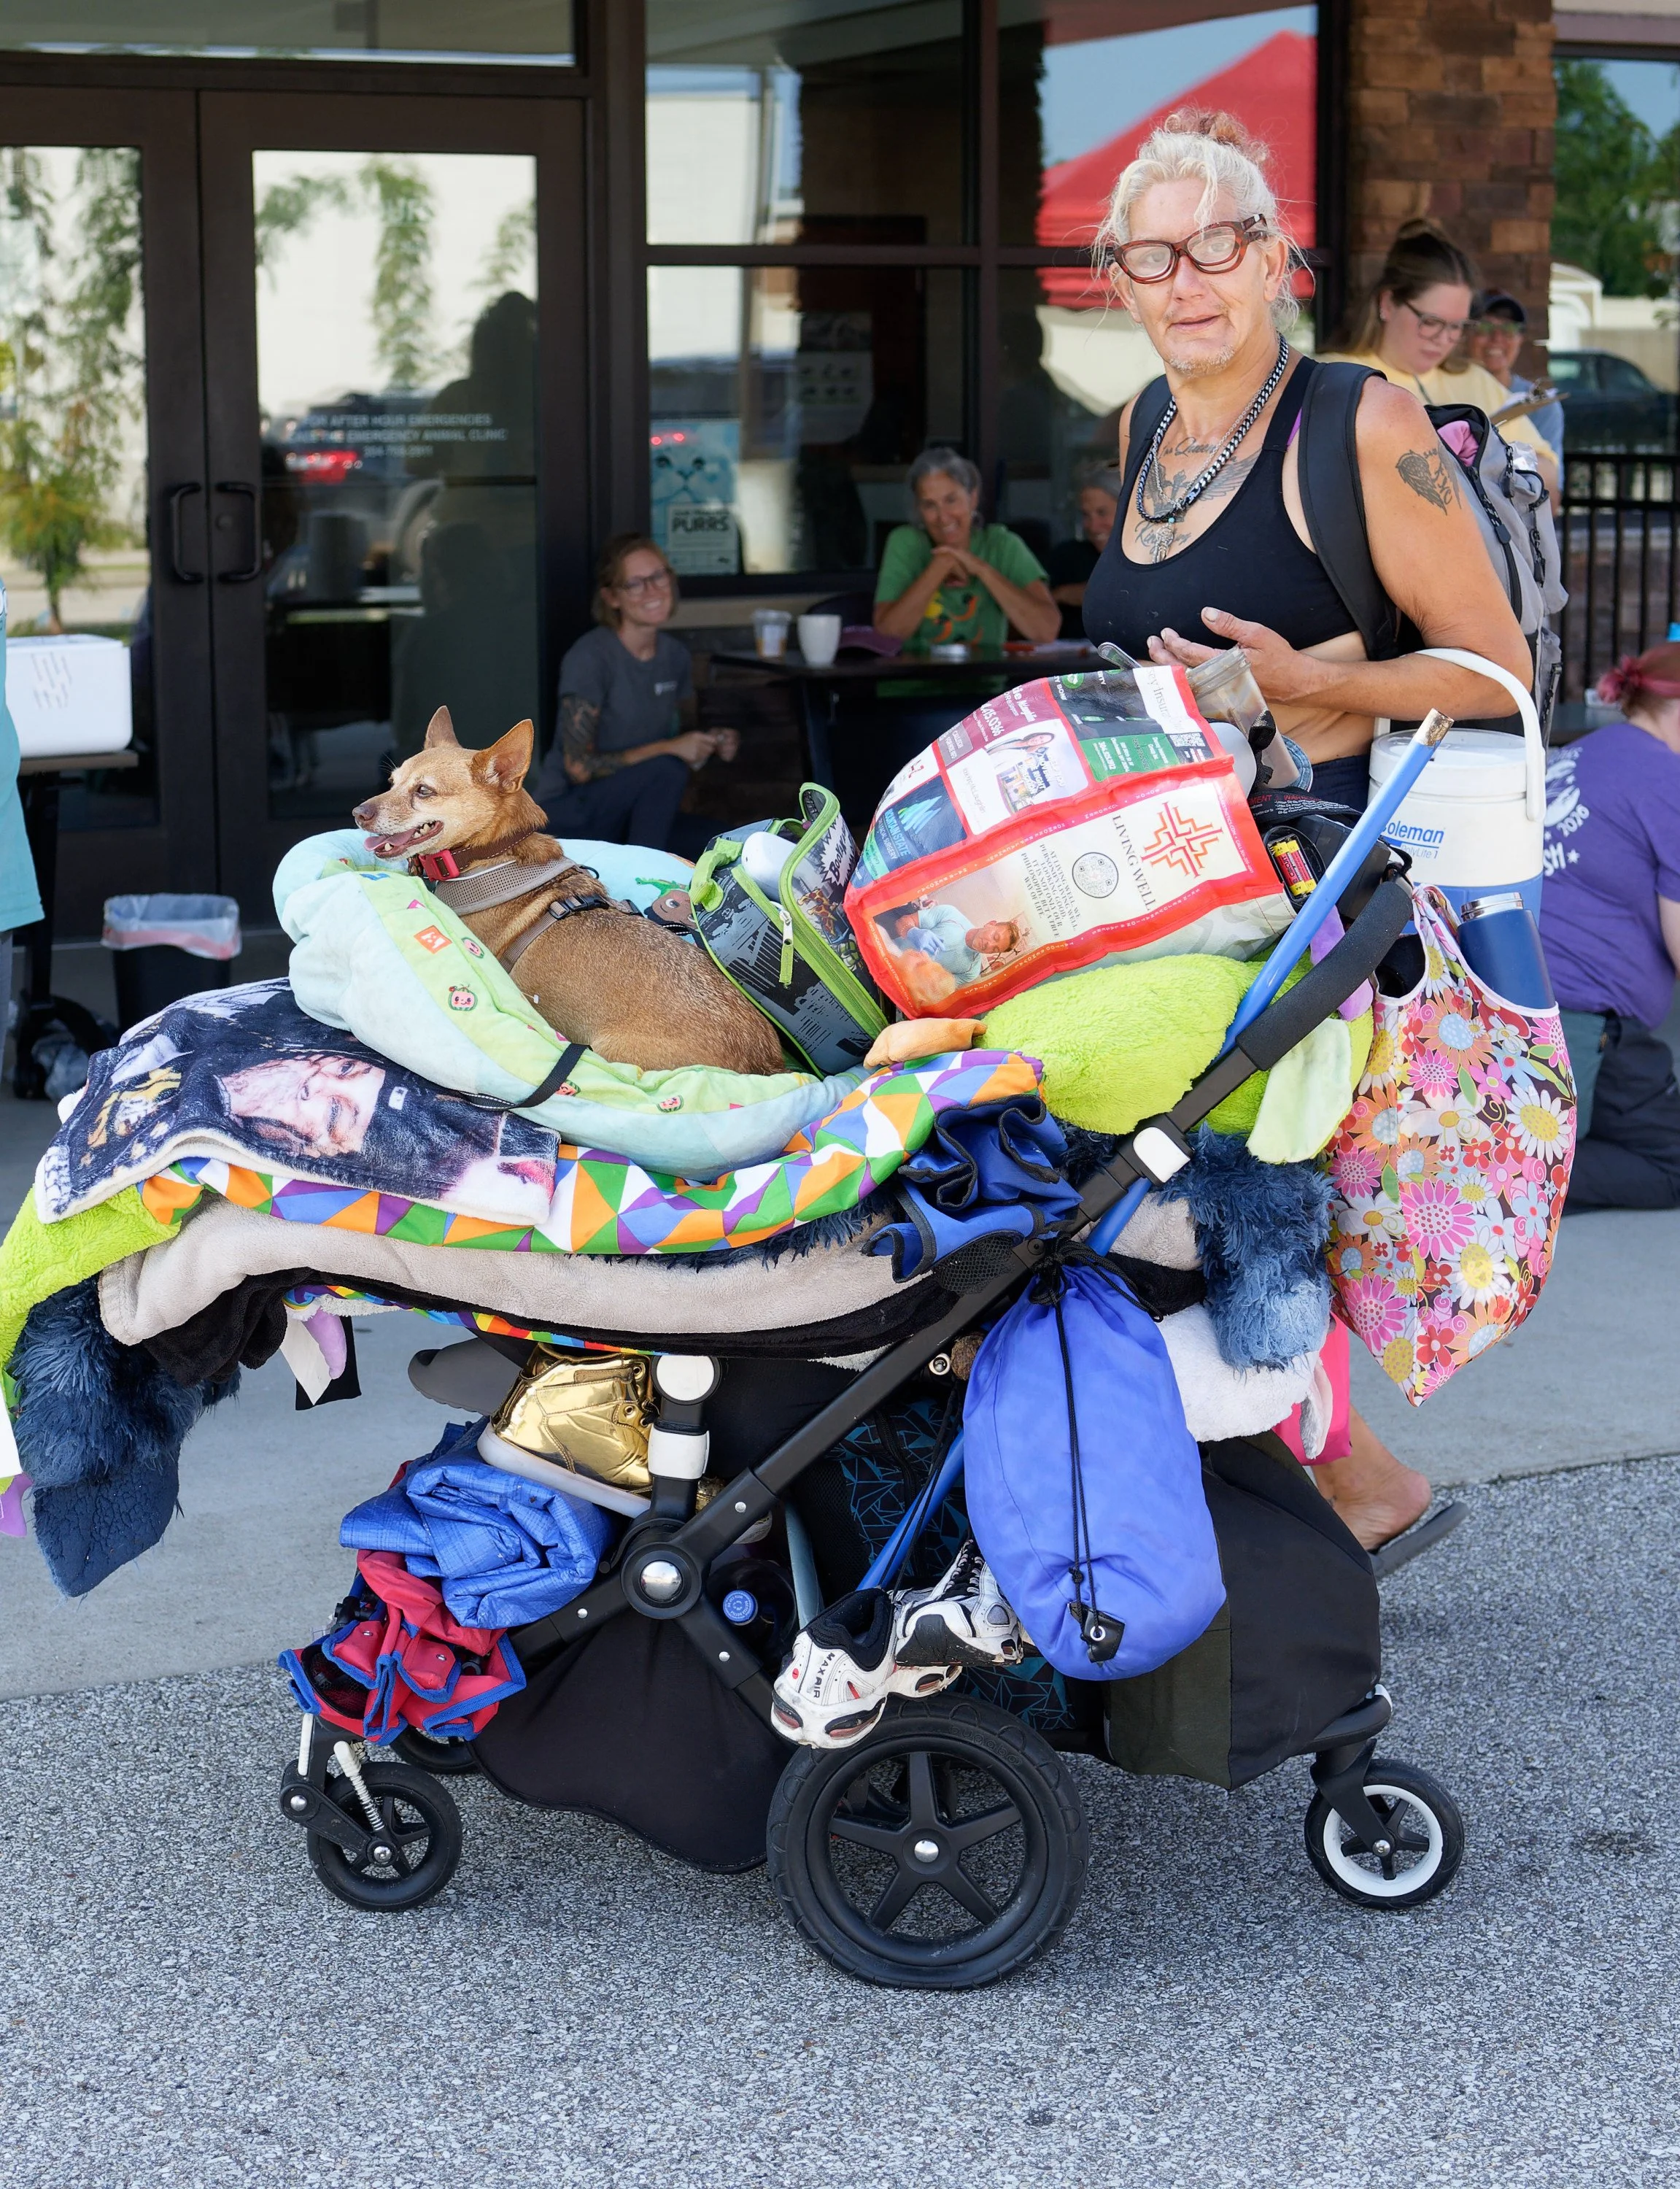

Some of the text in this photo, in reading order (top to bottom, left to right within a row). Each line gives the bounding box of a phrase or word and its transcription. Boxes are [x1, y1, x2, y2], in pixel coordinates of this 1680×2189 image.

[330, 414, 369, 427] AFTER
[371, 414, 406, 427] HOUR
[409, 413, 493, 427] EMERGENCIES
[347, 429, 421, 443] EMERGENCY
[422, 428, 466, 441] ANIMAL
[468, 428, 508, 441] CLINIC
[672, 516, 729, 532] PURRS
[986, 822, 1067, 862] HORMONE REPLACEMENT
[1382, 820, 1445, 843] oleman
[883, 838, 899, 860] SURGERY
[893, 833, 911, 857] STATE
[1112, 814, 1156, 911] LIVING WELL
[1543, 841, 1567, 876] SH
[916, 868, 967, 894] HAIR REMOVAL
[1023, 876, 1034, 892] WAY
[1030, 891, 1038, 900] OF
[1040, 843, 1060, 884] PERSONIFY
[1056, 883, 1070, 910] LIVING
[1040, 862, 1056, 896] LOOKING
[1054, 860, 1067, 886] LIVING
[1073, 906, 1081, 919] WE
[1040, 876, 1050, 892] NOT
[1045, 892, 1056, 911] ONLY
[1053, 911, 1063, 927] OUR
[1182, 888, 1201, 902] SKIN
[1040, 899, 1050, 913] BUT
[1049, 919, 1060, 938] TRUE
[1126, 899, 1182, 927] REJUVENATION
[1091, 925, 1119, 935] LASERS
[1014, 941, 1075, 969] TATTOO REMOVAL
[964, 978, 998, 995] FACIALS
